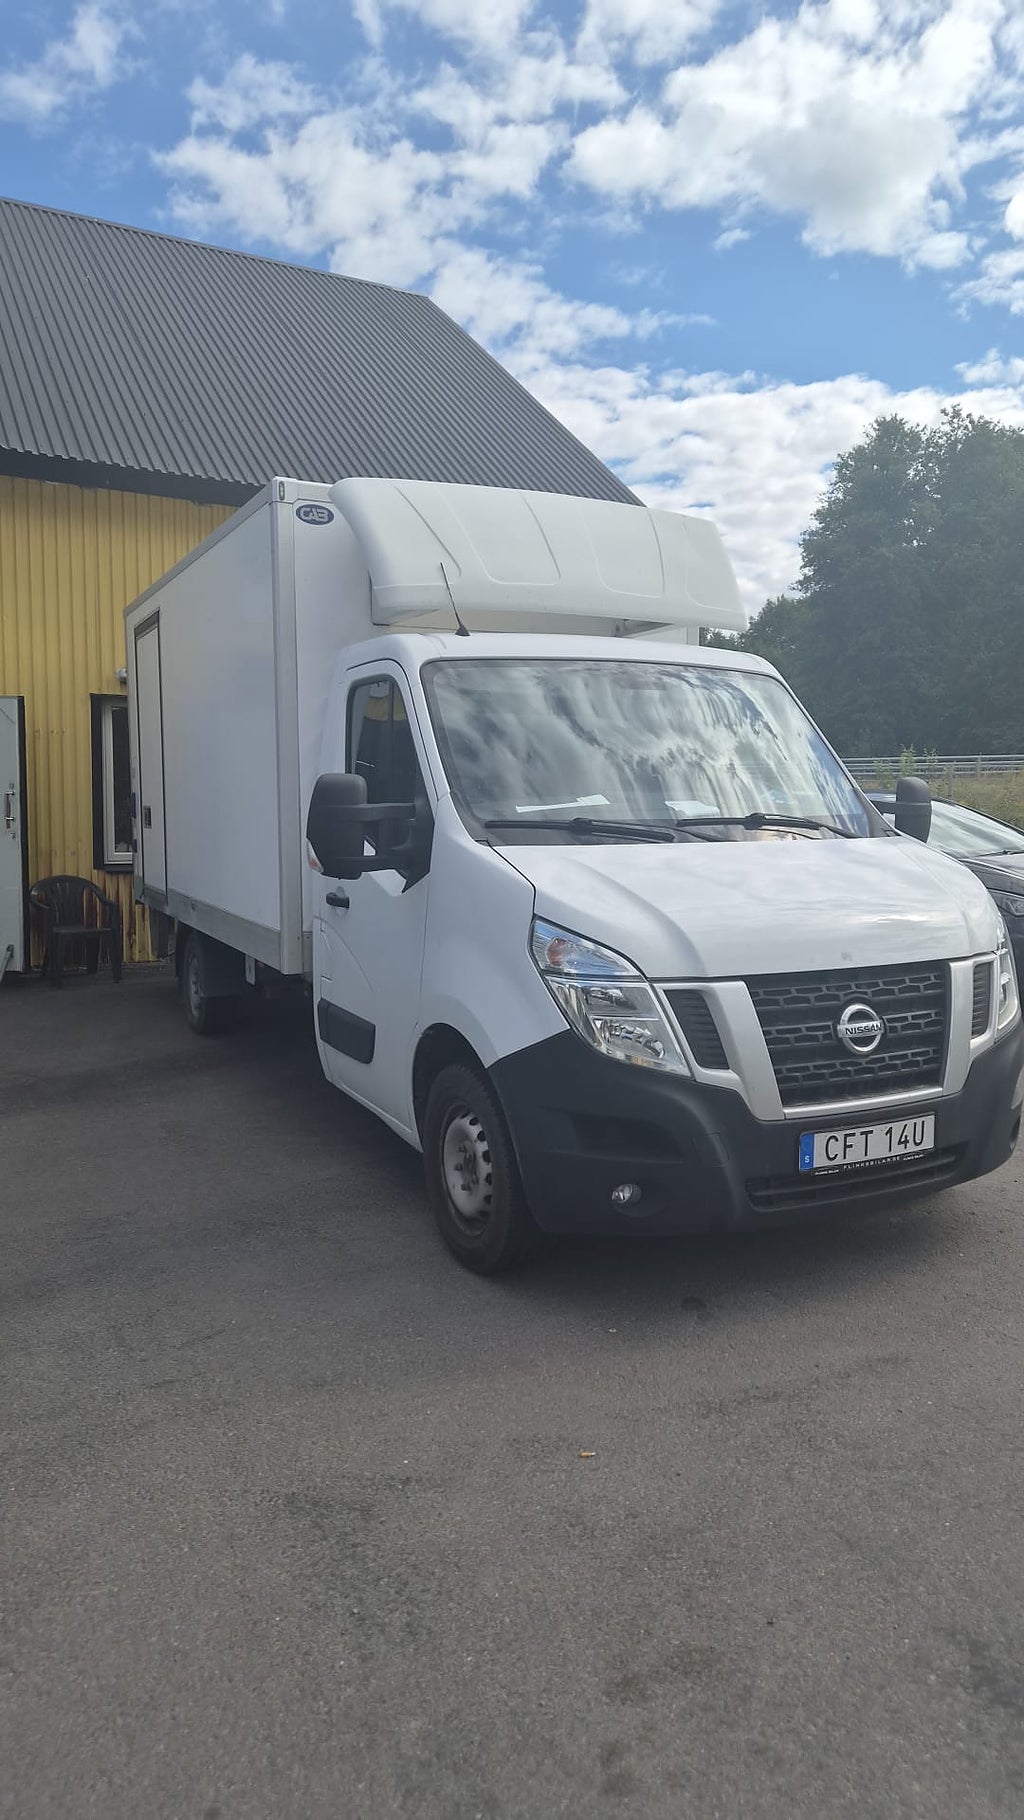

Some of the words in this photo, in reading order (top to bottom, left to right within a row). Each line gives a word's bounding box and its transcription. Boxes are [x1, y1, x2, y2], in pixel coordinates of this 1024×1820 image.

[845, 1022, 882, 1035] NISSAN
[825, 1130, 874, 1162] CFT
[884, 1120, 926, 1152] 14U
[804, 1155, 811, 1164] S
